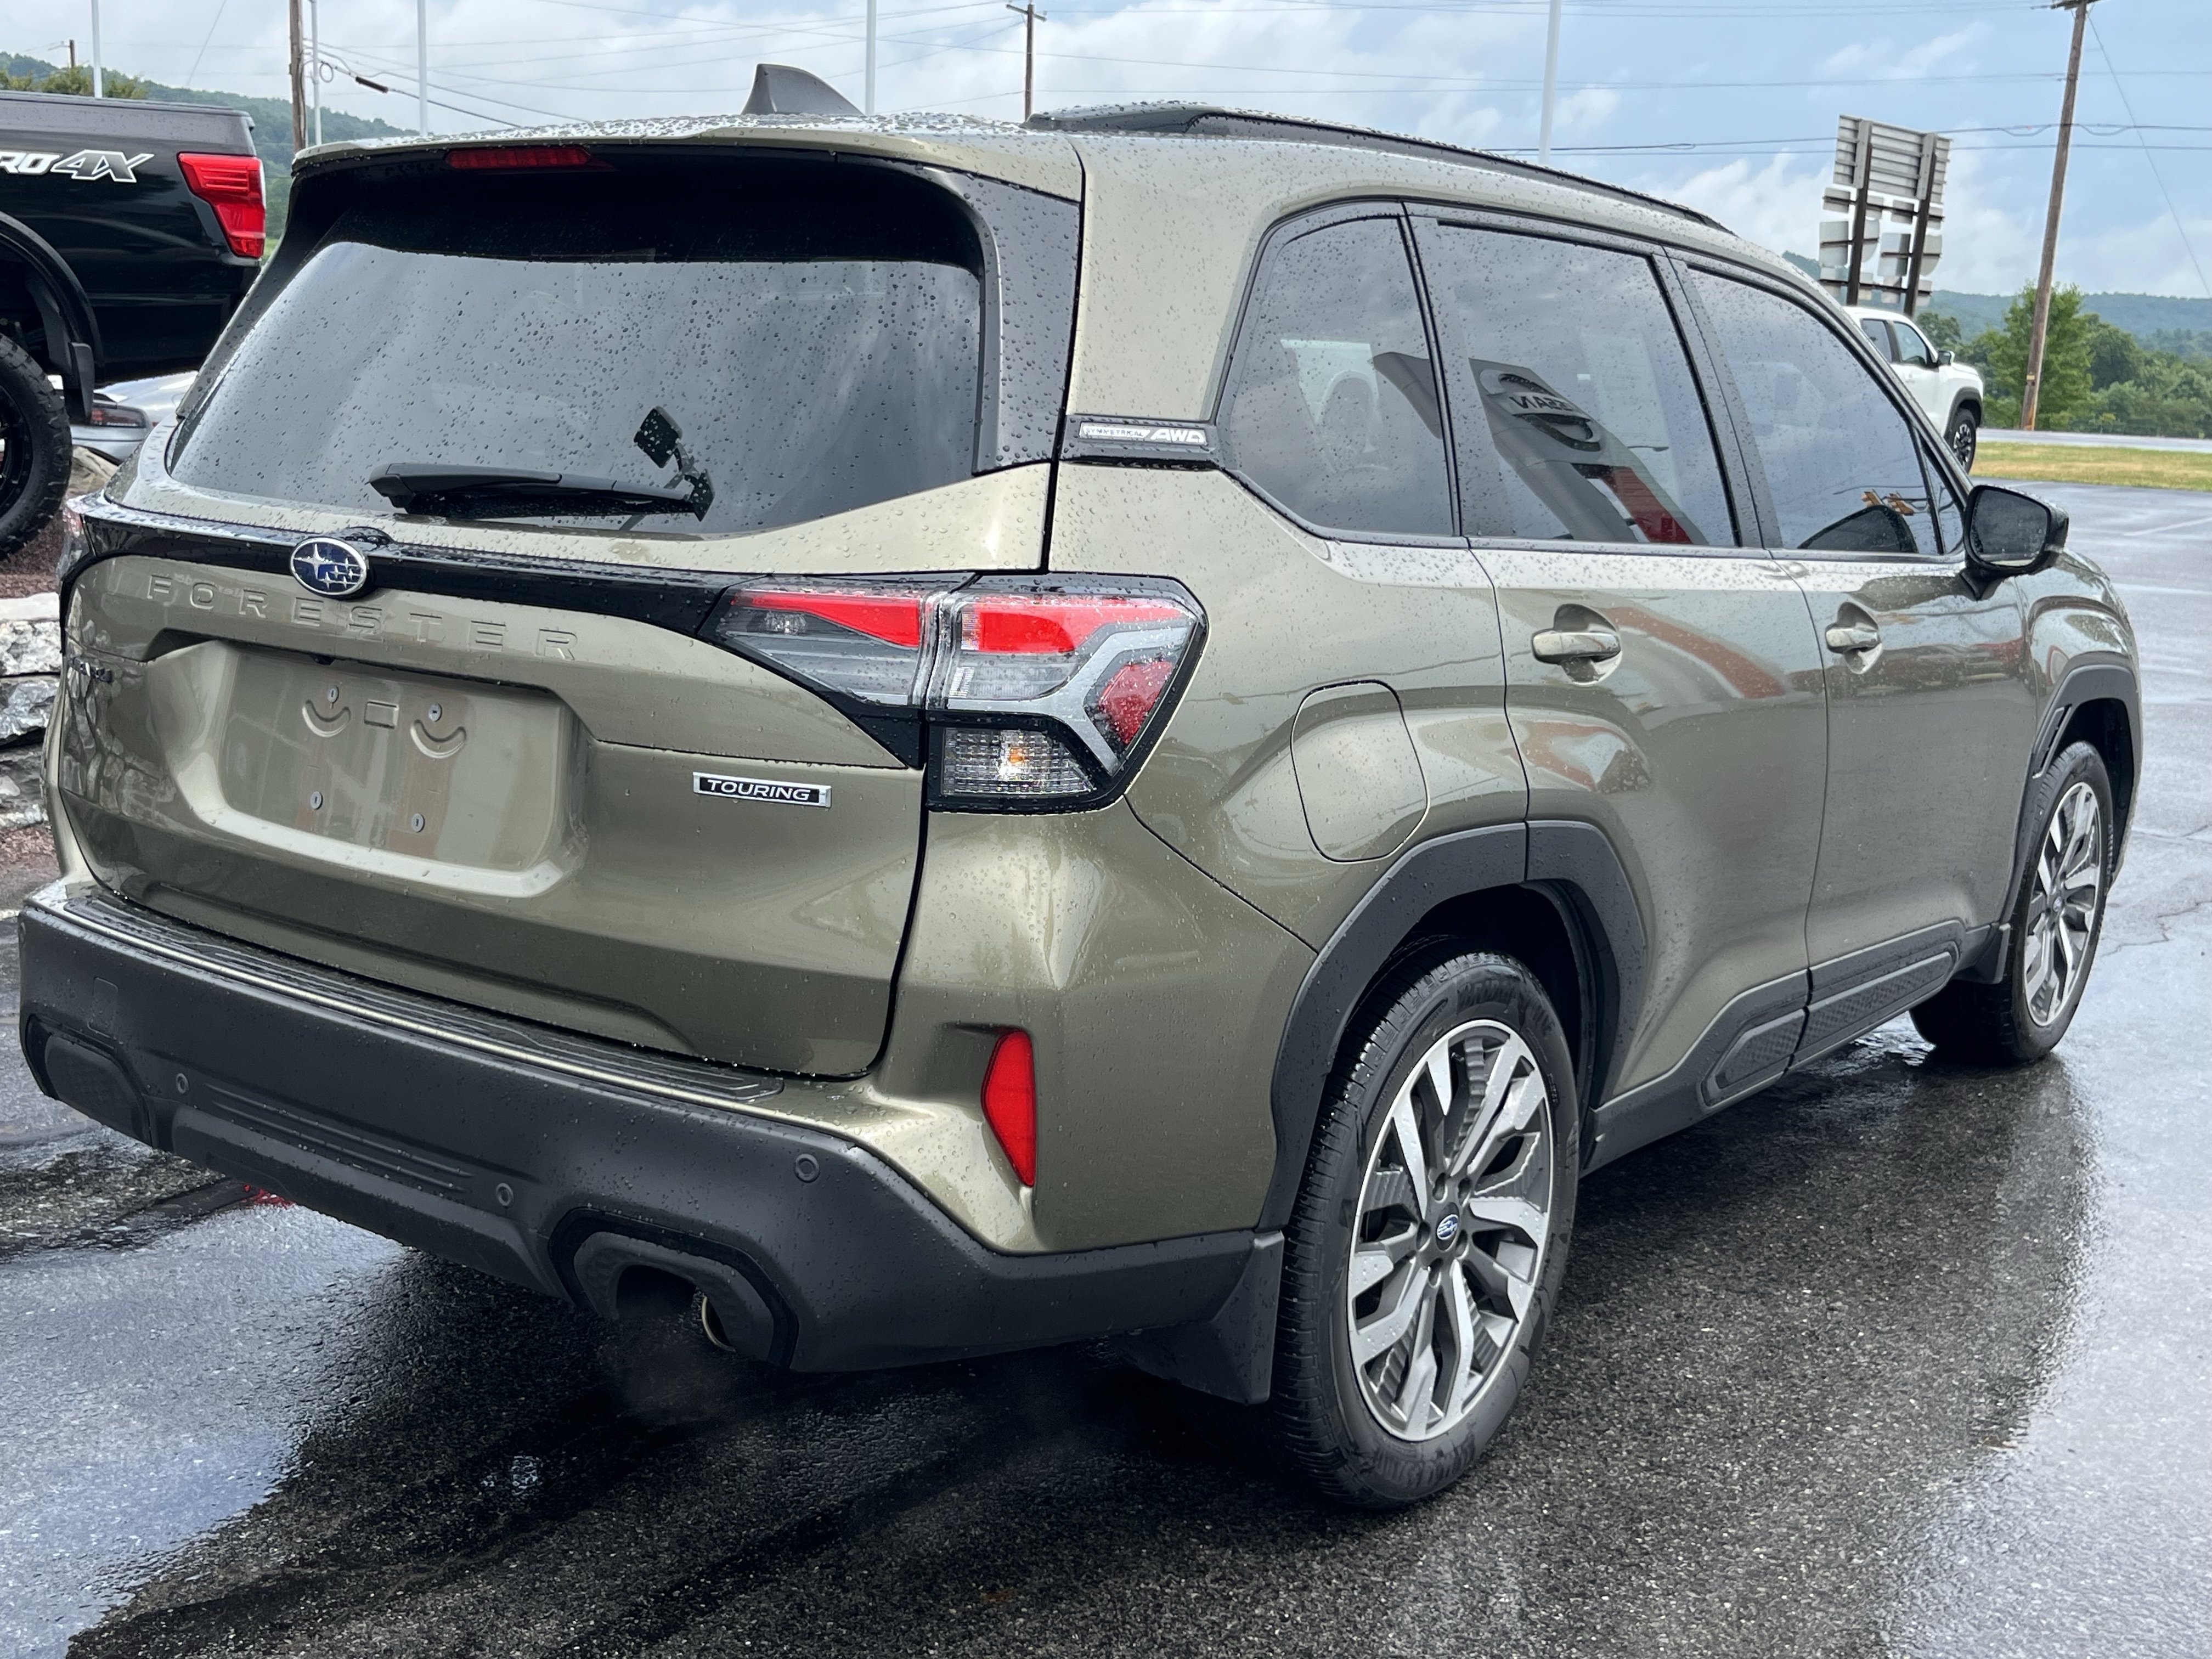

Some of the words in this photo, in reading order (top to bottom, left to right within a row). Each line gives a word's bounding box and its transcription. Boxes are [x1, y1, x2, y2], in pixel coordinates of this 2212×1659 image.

[1150, 428, 1206, 443] AWD
[146, 574, 579, 660] FORESTER
[707, 779, 811, 801] TOURING
